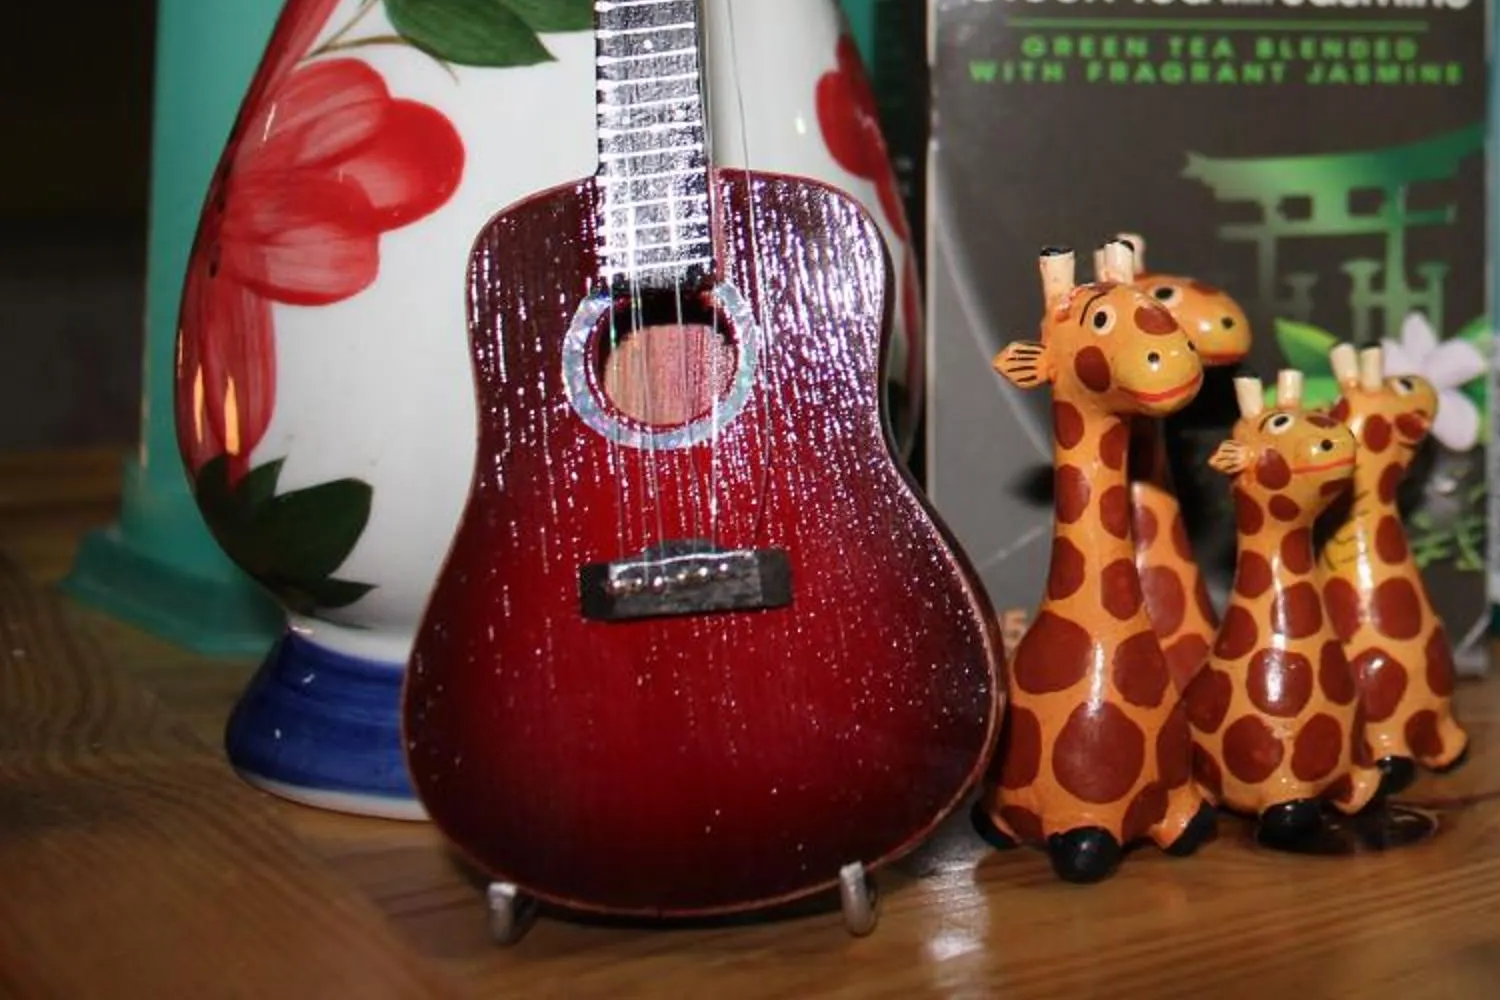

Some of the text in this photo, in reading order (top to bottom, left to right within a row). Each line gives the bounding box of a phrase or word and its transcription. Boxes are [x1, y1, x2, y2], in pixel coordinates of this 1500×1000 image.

[1020, 35, 1418, 61] GREEN TEA BLENDED
[968, 60, 1463, 87] WITH FRAGRANT JASMINE
